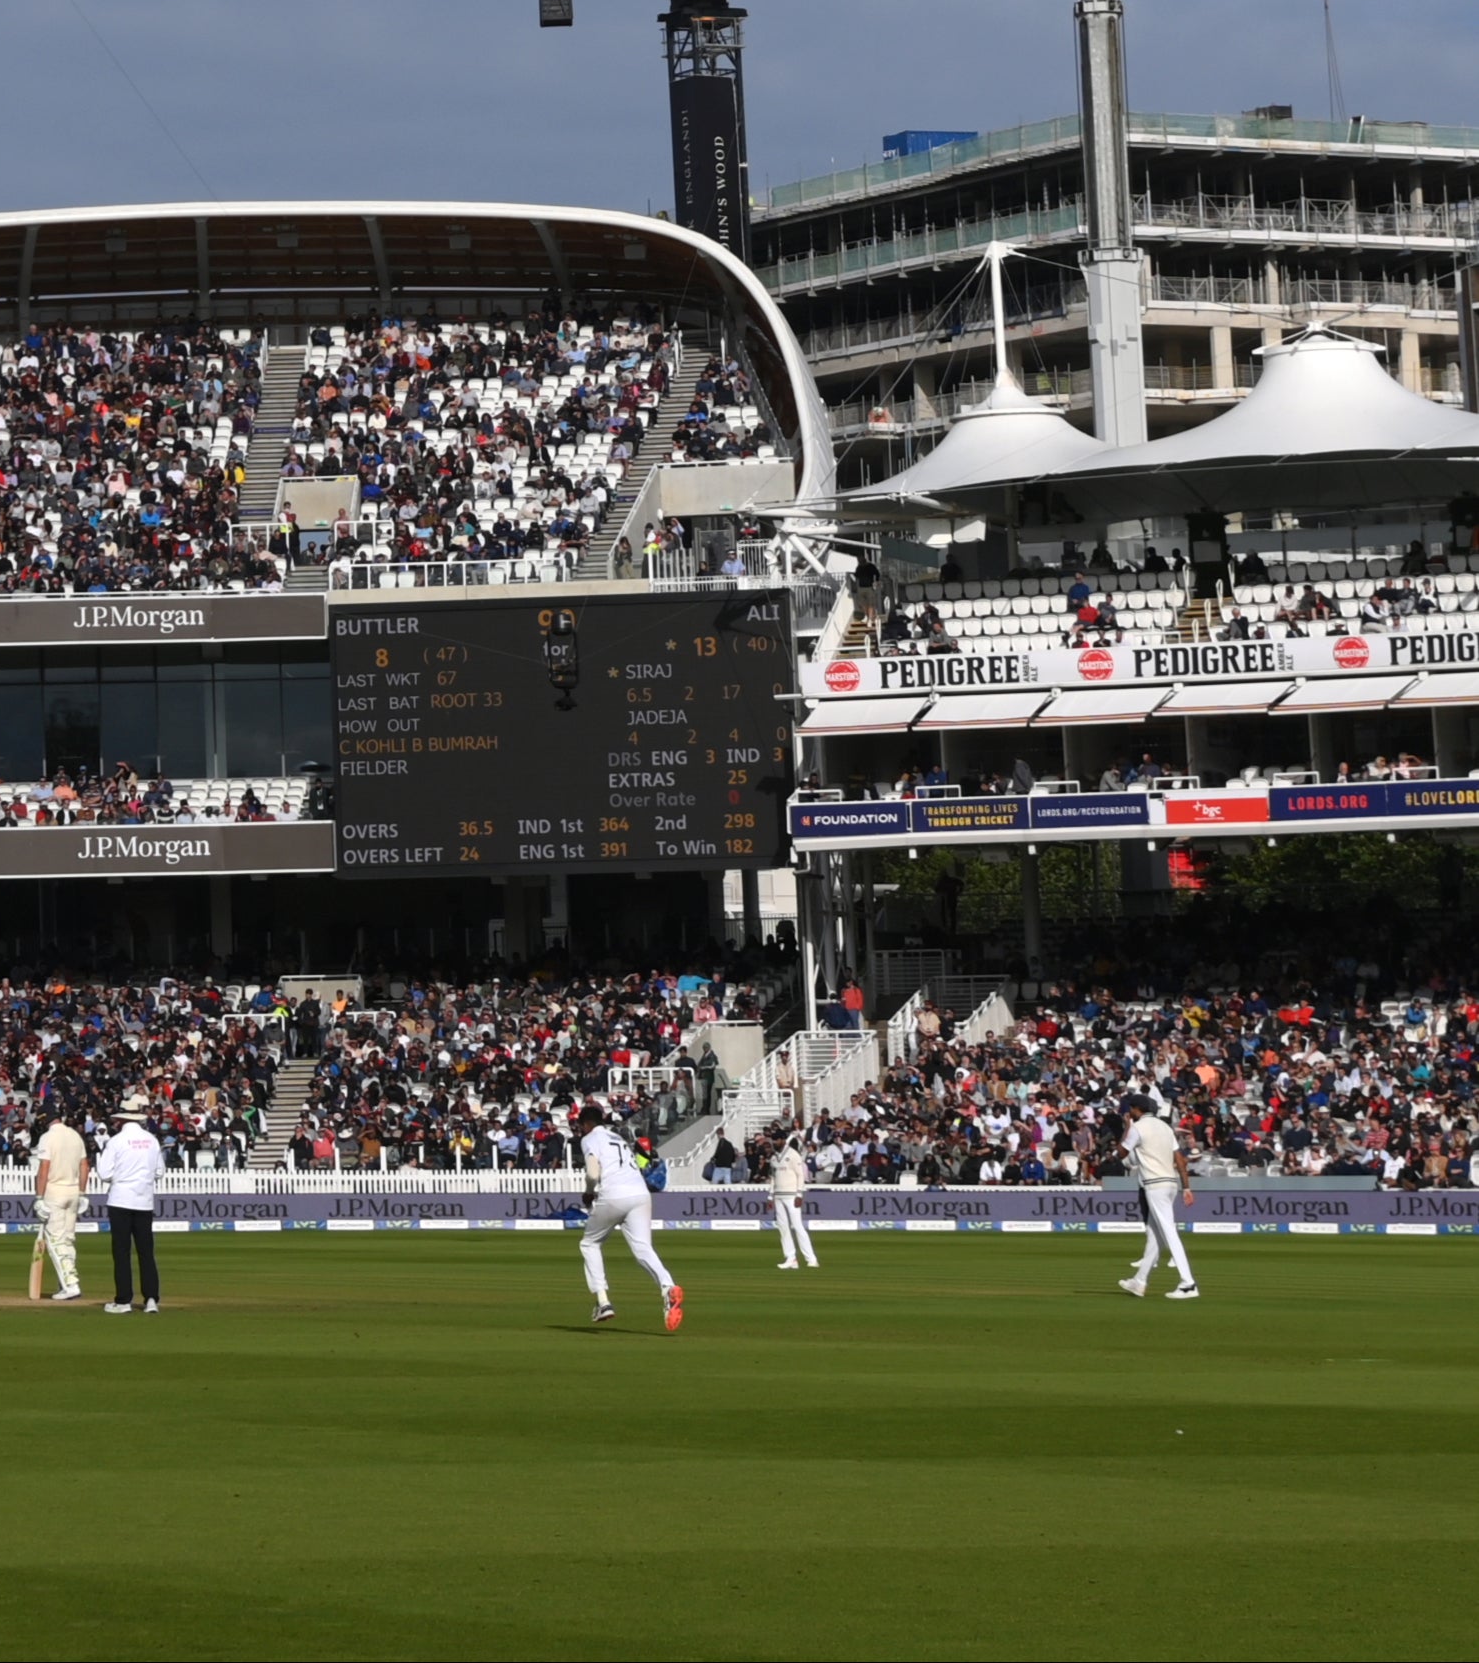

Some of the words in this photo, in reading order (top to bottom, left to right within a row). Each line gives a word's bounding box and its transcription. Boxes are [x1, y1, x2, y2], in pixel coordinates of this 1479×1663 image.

[714, 135, 727, 191] WOOD
[72, 605, 206, 634] J.P.Morgan
[746, 604, 781, 621] ALI
[336, 617, 420, 636] BUTTLER
[693, 637, 718, 656] 13
[1388, 633, 1479, 666] PEDIG
[375, 648, 389, 667] 8
[1133, 643, 1276, 678] PEDIGREE
[337, 674, 376, 688] LAST
[386, 672, 421, 686] WKT
[437, 671, 457, 686] 67
[625, 664, 672, 679] SIRAJ
[879, 654, 1020, 689] PEDIGREE
[338, 697, 377, 711] LAST
[389, 696, 420, 710] BAT
[430, 693, 478, 709] ROOT
[483, 692, 503, 707] 33
[626, 687, 653, 703] 6.5
[684, 686, 695, 701] 2
[722, 684, 741, 700] 17
[339, 719, 377, 734] HOW
[387, 718, 421, 732] OUT
[627, 709, 689, 726] JADEJA
[628, 731, 639, 745] 4
[687, 729, 697, 744] 2
[729, 728, 739, 742] 4
[776, 726, 787, 741] 0
[339, 739, 351, 755] C
[356, 738, 407, 754] KOHLI
[412, 737, 423, 752] B
[428, 736, 499, 752] BUMRAH
[608, 752, 641, 767] DRS
[651, 750, 688, 766] ENG
[705, 749, 716, 764] 3
[726, 748, 761, 764] IND
[772, 747, 784, 762] 3
[340, 760, 409, 776] FIELDER
[608, 772, 676, 788] EXTRAS
[727, 770, 748, 785] 25
[609, 792, 651, 808] Over
[656, 792, 697, 807] Rate
[922, 805, 991, 816] TRANSFORMING
[993, 803, 1019, 814] LIVES
[1288, 794, 1369, 811] LORDS.ORG
[814, 813, 899, 827] FOUNDATION
[1202, 803, 1222, 818] bgc
[342, 824, 399, 839] OVERS
[458, 820, 493, 836] 36.5
[517, 819, 551, 835] IND
[559, 819, 584, 833] 1st
[598, 817, 631, 832] 364
[654, 814, 687, 830] 2nd
[724, 813, 756, 829] 298
[927, 816, 972, 827] THROUGH
[974, 814, 1014, 826] CRICKET
[77, 835, 212, 866] J.P.Morgan
[343, 848, 400, 864] OVERS
[405, 847, 444, 863] LEFT
[459, 846, 480, 861] 24
[519, 844, 555, 860] ENG
[561, 843, 586, 858] 1st
[600, 842, 628, 857] 391
[656, 840, 678, 856] To
[683, 839, 717, 855] Win
[725, 838, 754, 854] 182
[152, 1199, 289, 1220] J.P.Morgan
[328, 1198, 465, 1220] J.P.Morgan
[850, 1196, 991, 1220] J.P.Morgan
[1211, 1196, 1350, 1222] J.P.Morgan
[1389, 1196, 1479, 1218] J.P.Mor
